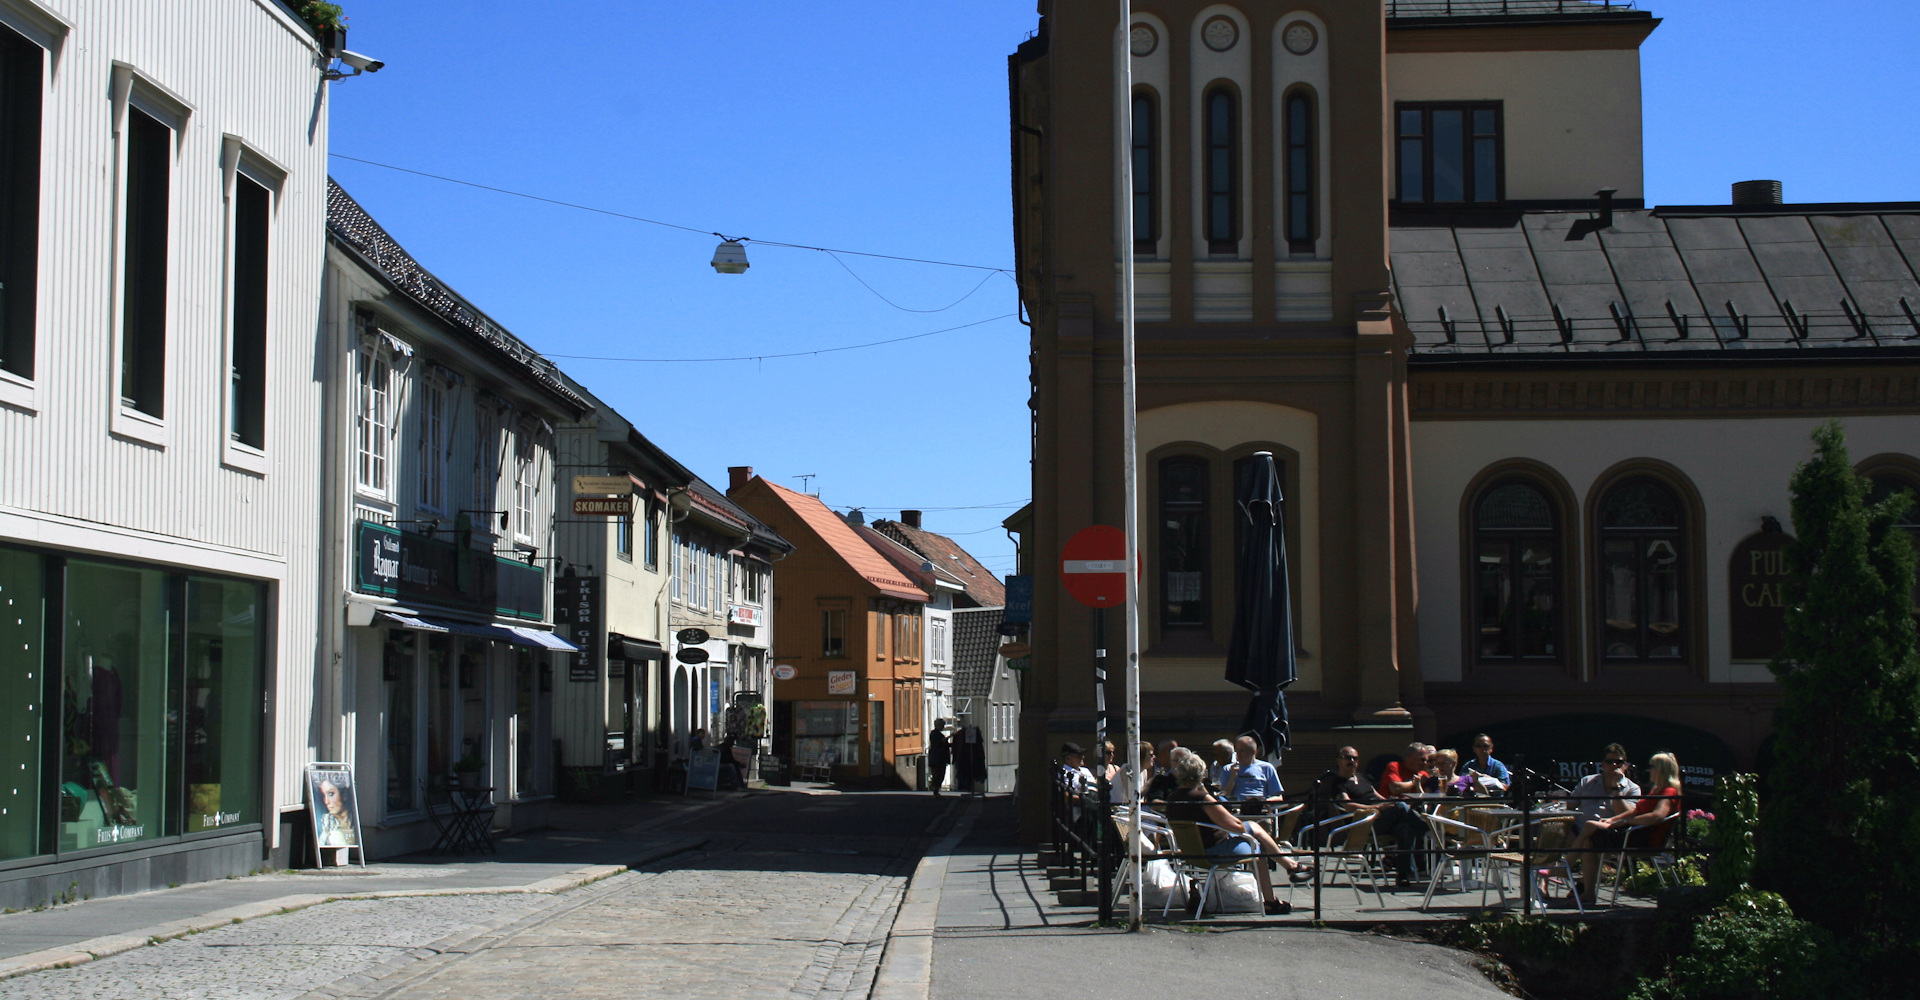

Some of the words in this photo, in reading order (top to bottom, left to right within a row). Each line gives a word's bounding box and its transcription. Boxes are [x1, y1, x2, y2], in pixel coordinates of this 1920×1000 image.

[575, 501, 629, 512] SKOMAKER
[373, 539, 399, 582] Ragnar
[578, 580, 591, 623] FRISØR
[1742, 583, 1790, 607] CA
[1008, 600, 1032, 611] Kref
[577, 629, 591, 666] GITTE
[830, 673, 853, 684] Gledes
[1559, 762, 1588, 778] BIG
[1680, 765, 1714, 776] ARRIS
[1685, 776, 1715, 787] PEPSI
[203, 814, 215, 827] FRIIS
[221, 812, 240, 825] COMPANY
[97, 829, 111, 843] FRIIS
[120, 825, 144, 840] COMPANY
